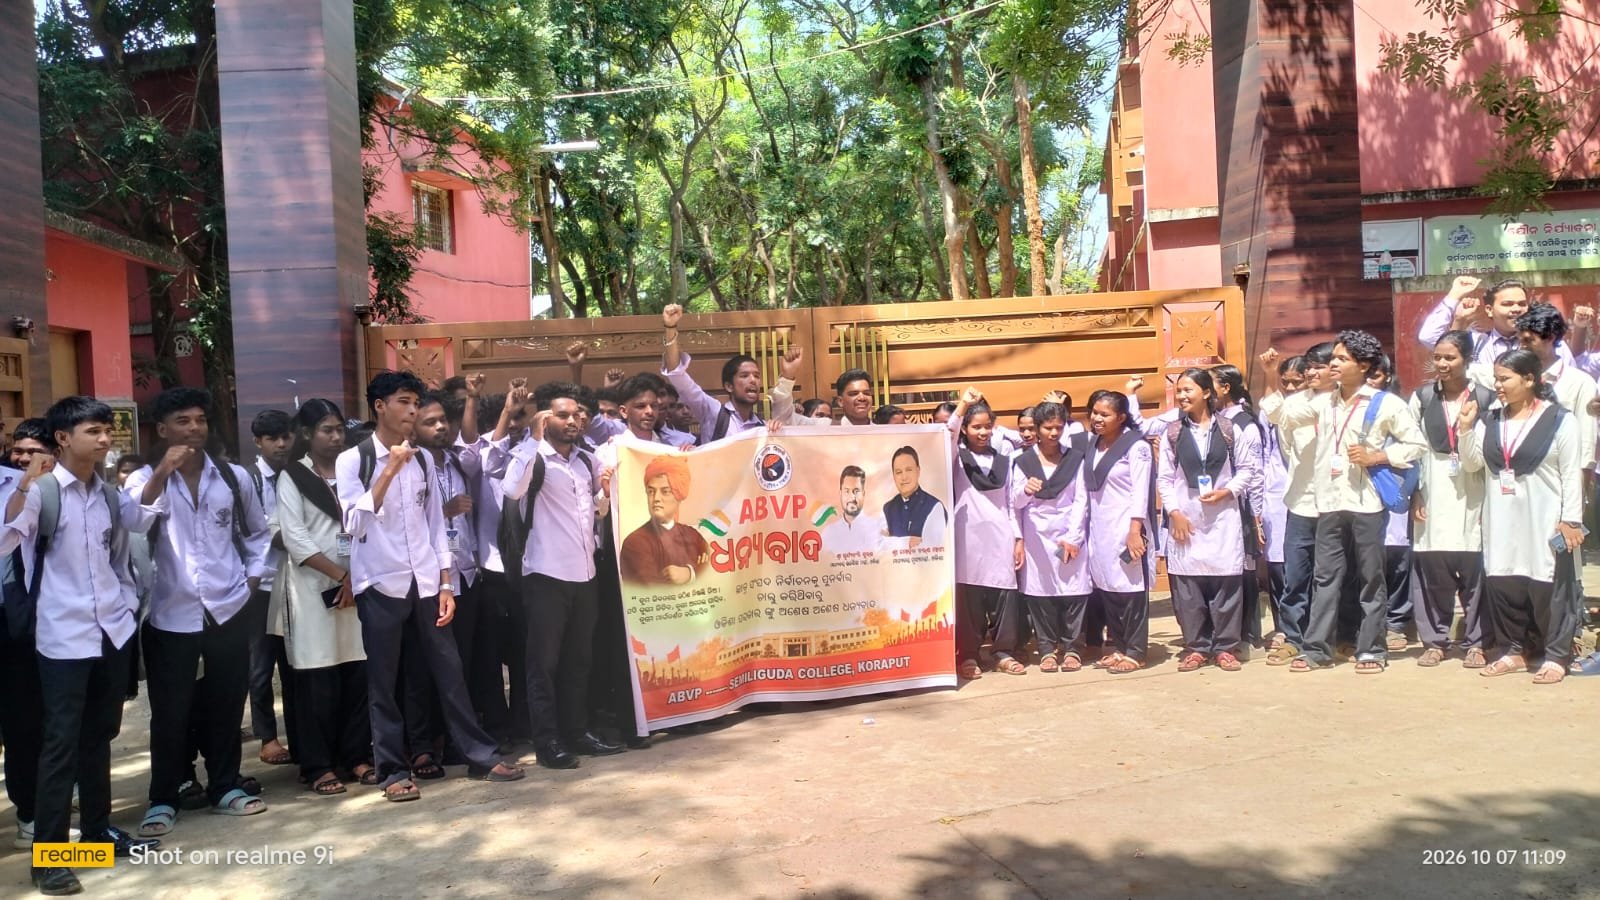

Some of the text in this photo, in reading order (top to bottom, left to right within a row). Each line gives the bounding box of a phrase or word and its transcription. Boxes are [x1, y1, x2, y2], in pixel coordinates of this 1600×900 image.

[739, 495, 807, 524] ABVP
[710, 530, 823, 573] ଧନ୍ୟବାଦ
[756, 589, 824, 604] ଚାଲୁ କରିଥିବାରୁ
[667, 656, 911, 705] ABVP SEMILIGUDA COLLEGE, KORAPUT
